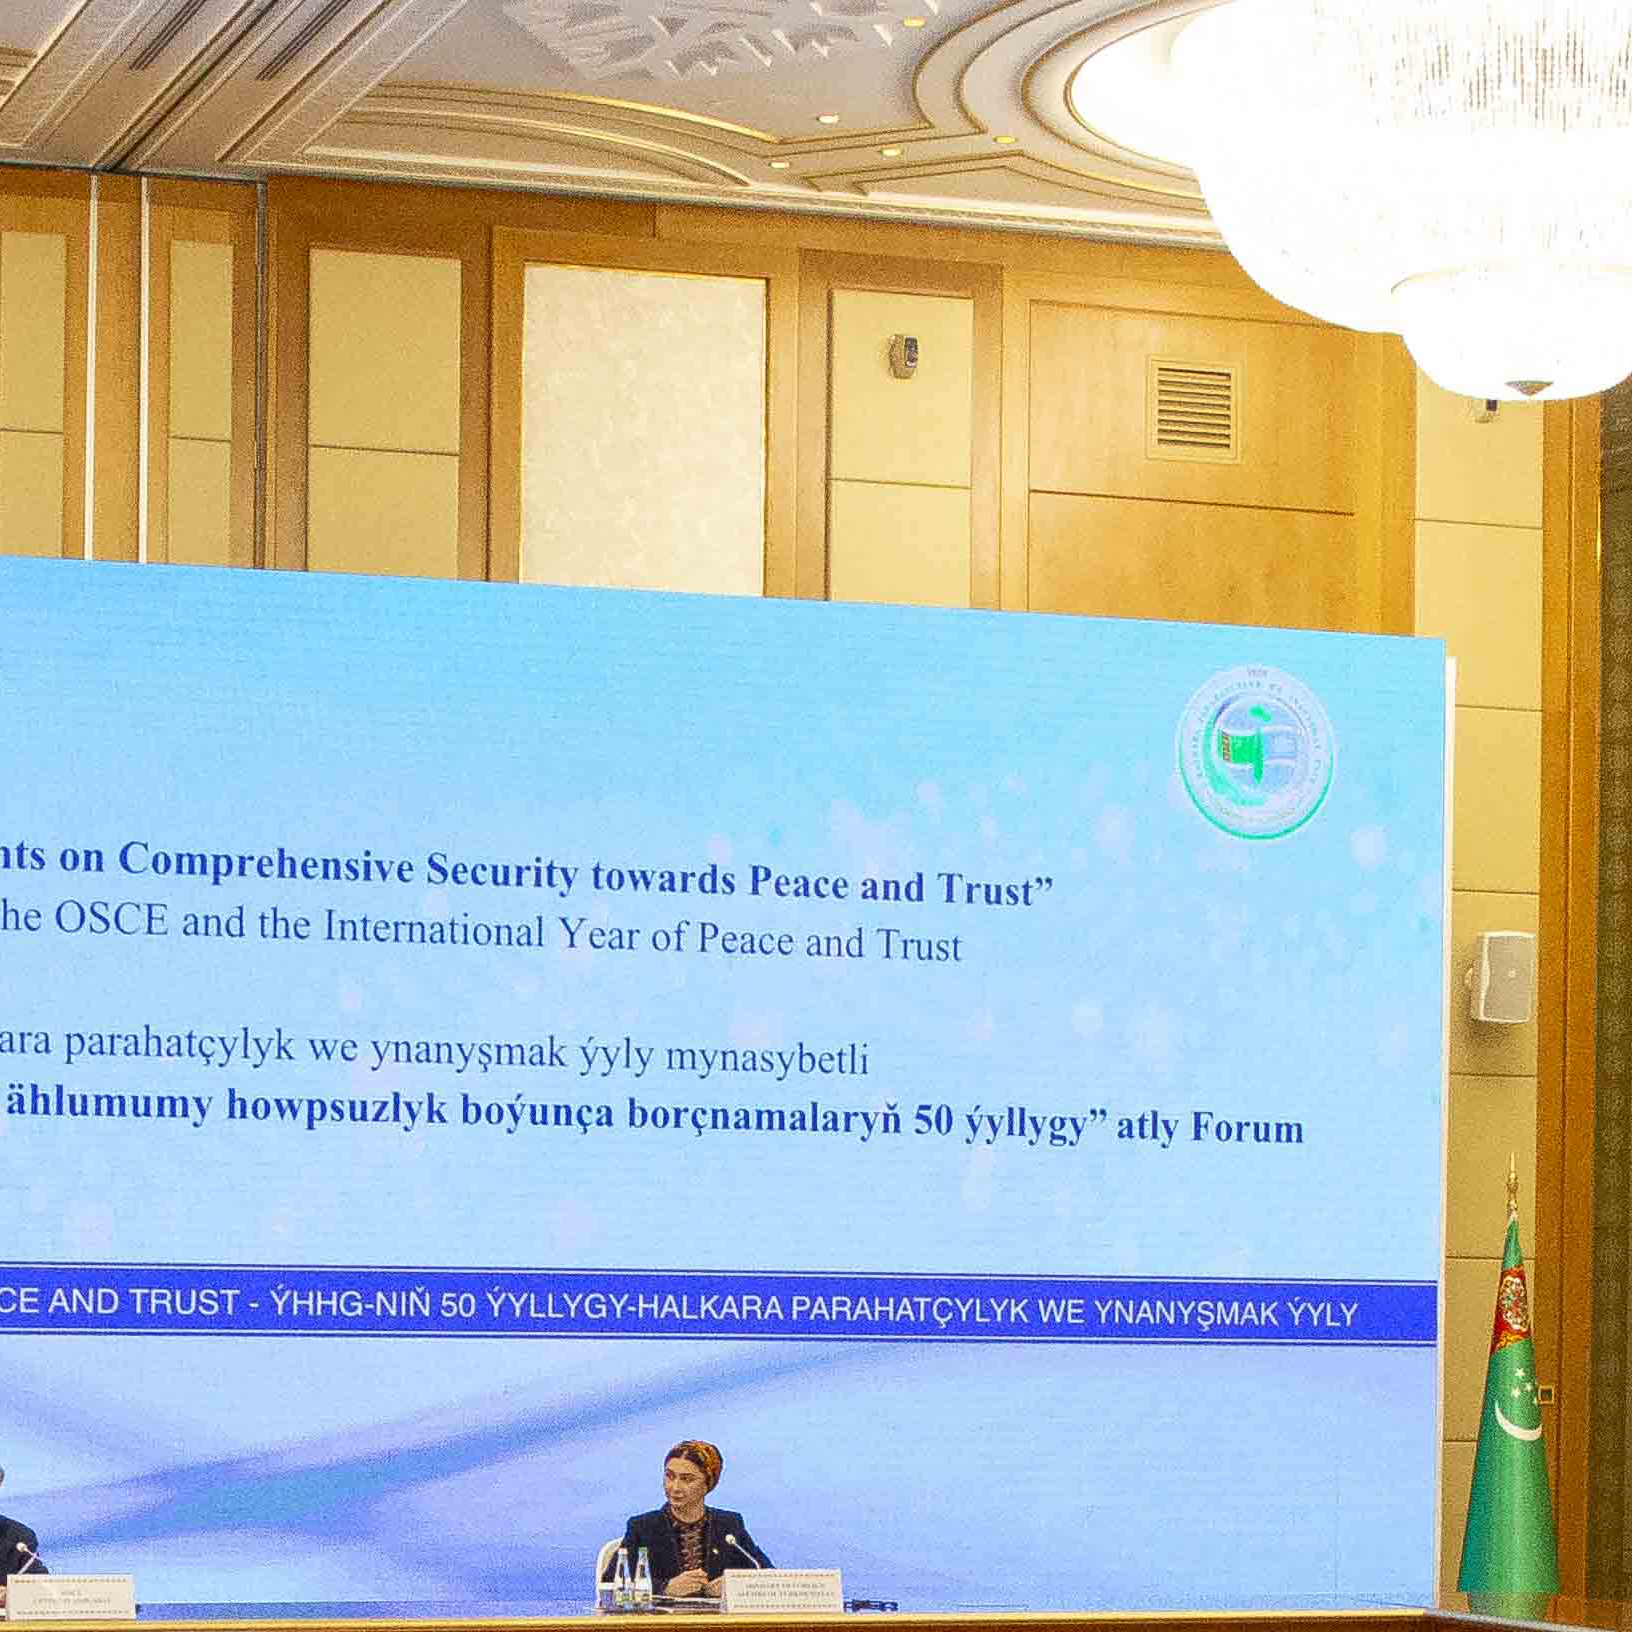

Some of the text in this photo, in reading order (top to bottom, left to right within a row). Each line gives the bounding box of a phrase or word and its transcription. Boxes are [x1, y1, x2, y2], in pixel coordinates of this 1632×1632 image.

[59, 848, 104, 873] on
[118, 840, 414, 886] Comprehensive
[426, 852, 576, 898] Security
[592, 862, 736, 895] towards
[750, 864, 849, 900] Peace
[861, 871, 924, 903] and
[54, 899, 168, 936] OSCE
[182, 905, 246, 939] and
[258, 906, 311, 941] the
[325, 908, 544, 948] International
[559, 916, 641, 951] Year
[651, 919, 691, 953] of
[699, 921, 794, 957] Peace
[805, 926, 865, 959] and
[876, 928, 961, 962] Trust
[65, 1023, 295, 1070] parahatçylyk
[308, 1038, 358, 1063] we
[370, 1034, 566, 1074] ynanyşmak
[579, 1035, 654, 1079] ýyly
[666, 1041, 868, 1082] mynasybetli
[6, 1083, 211, 1129] ählumumy
[227, 1087, 448, 1133] howpsuzlyk
[461, 1093, 614, 1135] boýunça
[628, 1096, 901, 1143] borçnamalaryň
[914, 1103, 954, 1135] 50
[965, 1104, 1108, 1147] ýyllygy”
[1117, 1109, 1178, 1150] atly
[1192, 1110, 1304, 1144] Forum
[48, 1288, 119, 1314] AND
[130, 1288, 239, 1315] TRUST
[271, 1286, 432, 1317] ÝHHG-NIŇ
[441, 1292, 476, 1317] 50
[487, 1287, 783, 1321] ÝYLLYGY-HALKARA
[792, 1295, 1028, 1327] PARAHATÇYLYK
[1038, 1299, 1084, 1323] WE
[1095, 1300, 1278, 1329] YNANYŞMAK
[1288, 1296, 1358, 1326] ÝYLY
